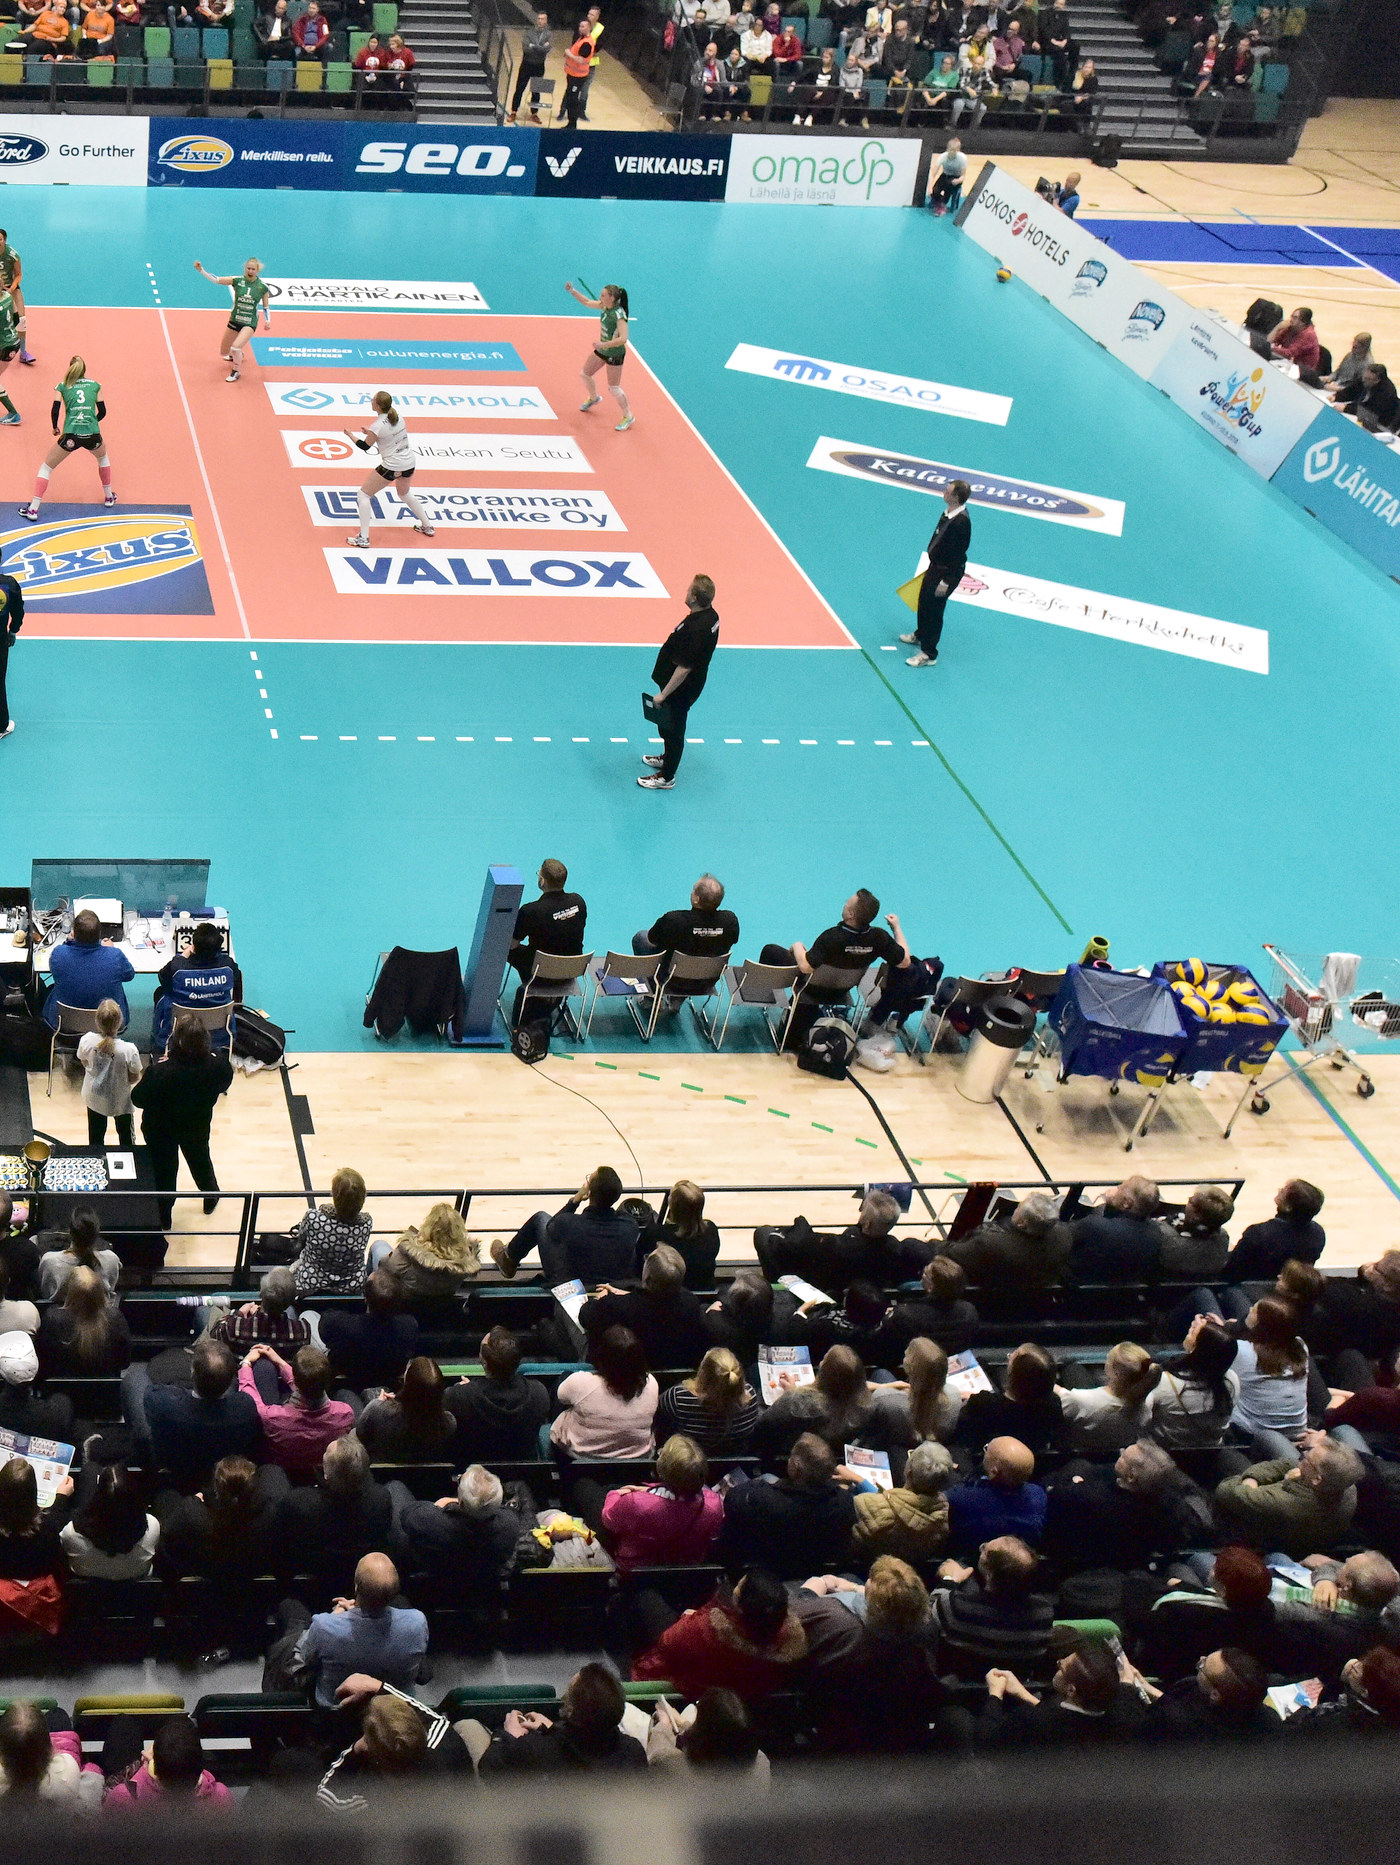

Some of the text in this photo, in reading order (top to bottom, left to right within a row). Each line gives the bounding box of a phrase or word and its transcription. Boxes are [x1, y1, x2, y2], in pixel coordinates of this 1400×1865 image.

[59, 144, 135, 159] Go Further
[158, 139, 226, 165] Fixus
[241, 149, 334, 162] Merkillisen reilu.
[615, 156, 724, 176] VEIKKAUS.FI
[749, 186, 836, 201] Lähellä ja läsnä
[978, 188, 1070, 267] SOKOS HOTELS
[288, 290, 480, 301] HARTIKAINEN
[367, 350, 504, 361] oulunenergia.fi
[841, 374, 942, 403] OSAO
[76, 390, 86, 404] 3
[1200, 381, 1235, 413] Power
[413, 446, 493, 459] Nilakan
[501, 447, 572, 460] Seutu
[868, 458, 1060, 509] Kalaeuvos
[387, 491, 592, 507] Levorannan
[396, 507, 608, 528] Autoliike Oy
[342, 556, 645, 588] VALLOX
[185, 975, 227, 987] FINLAND
